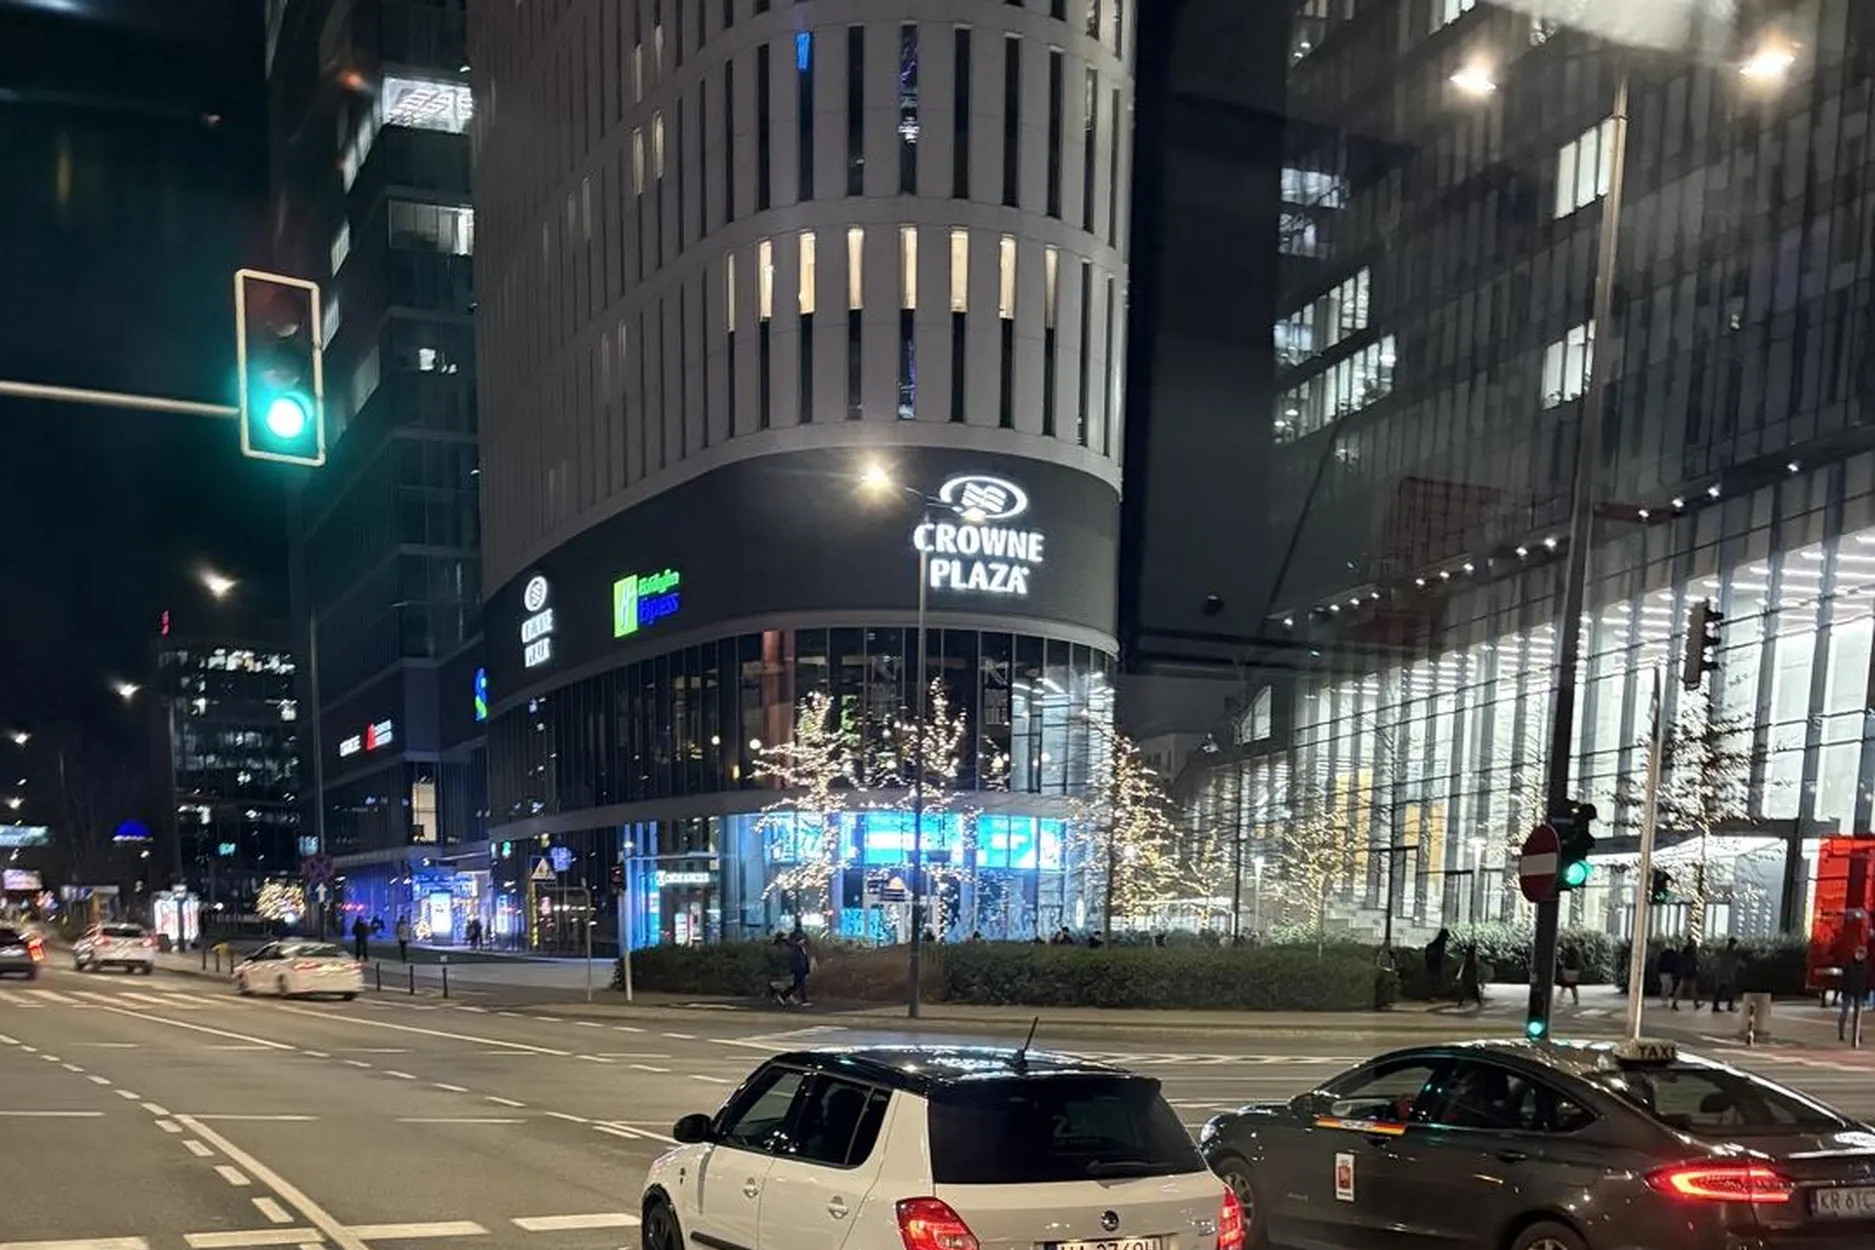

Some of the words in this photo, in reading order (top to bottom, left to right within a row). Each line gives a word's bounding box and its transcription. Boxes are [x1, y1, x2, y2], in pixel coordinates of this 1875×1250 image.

[912, 522, 1045, 563] CROWNE
[930, 557, 1028, 594] PLAZA
[1638, 1042, 1676, 1060] TAXI
[1820, 1190, 1840, 1210] KR
